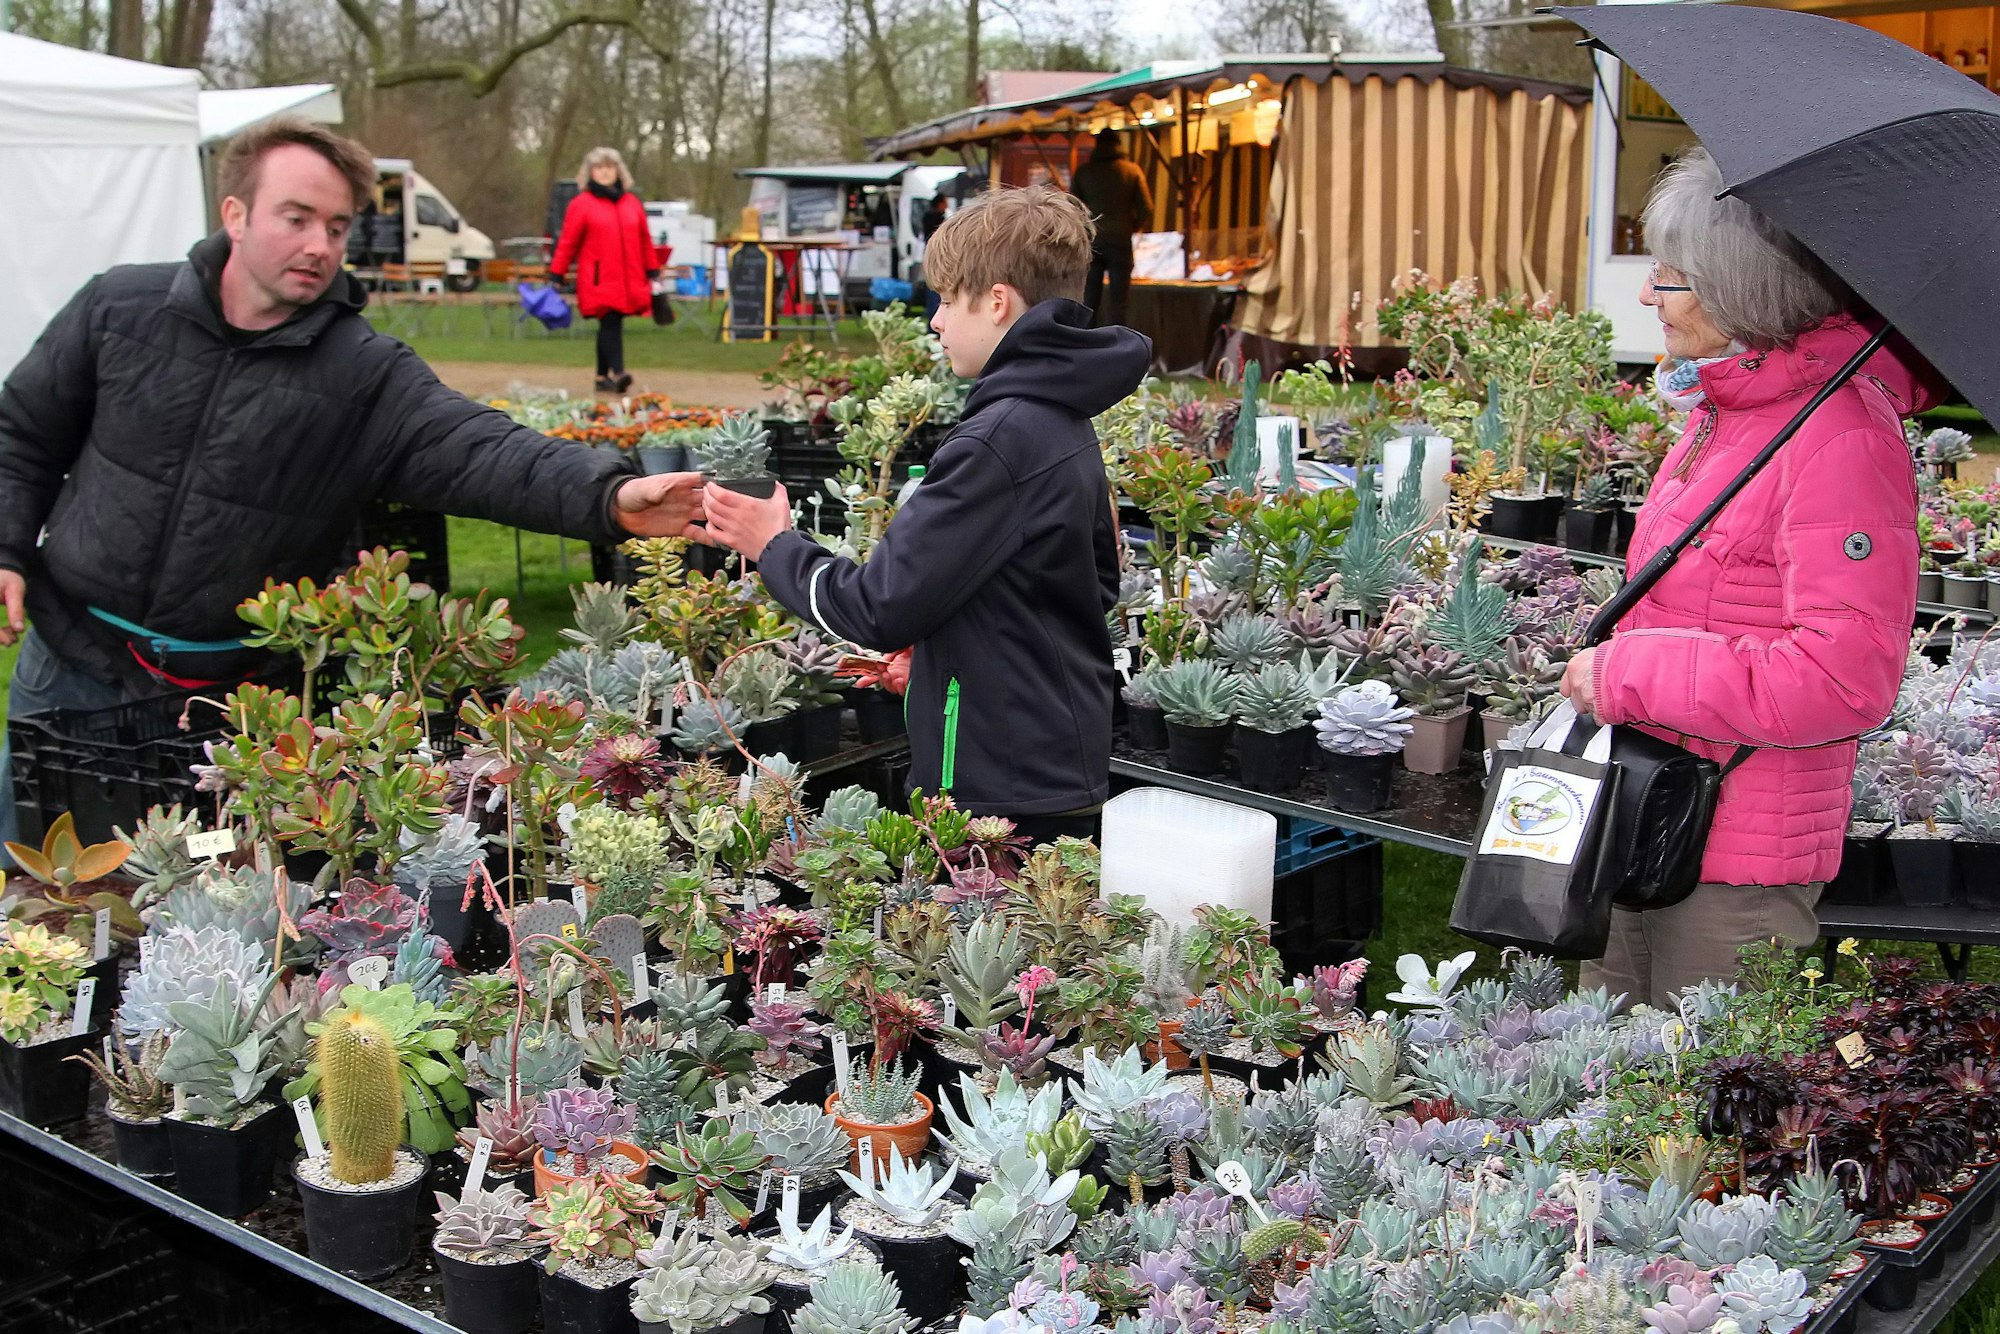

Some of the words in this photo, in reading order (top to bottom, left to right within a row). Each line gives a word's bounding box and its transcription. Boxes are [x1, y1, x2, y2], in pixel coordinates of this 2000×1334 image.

[356, 962, 378, 977] 20€
[298, 1100, 309, 1114] 6€
[1223, 1169, 1242, 1188] 3€
